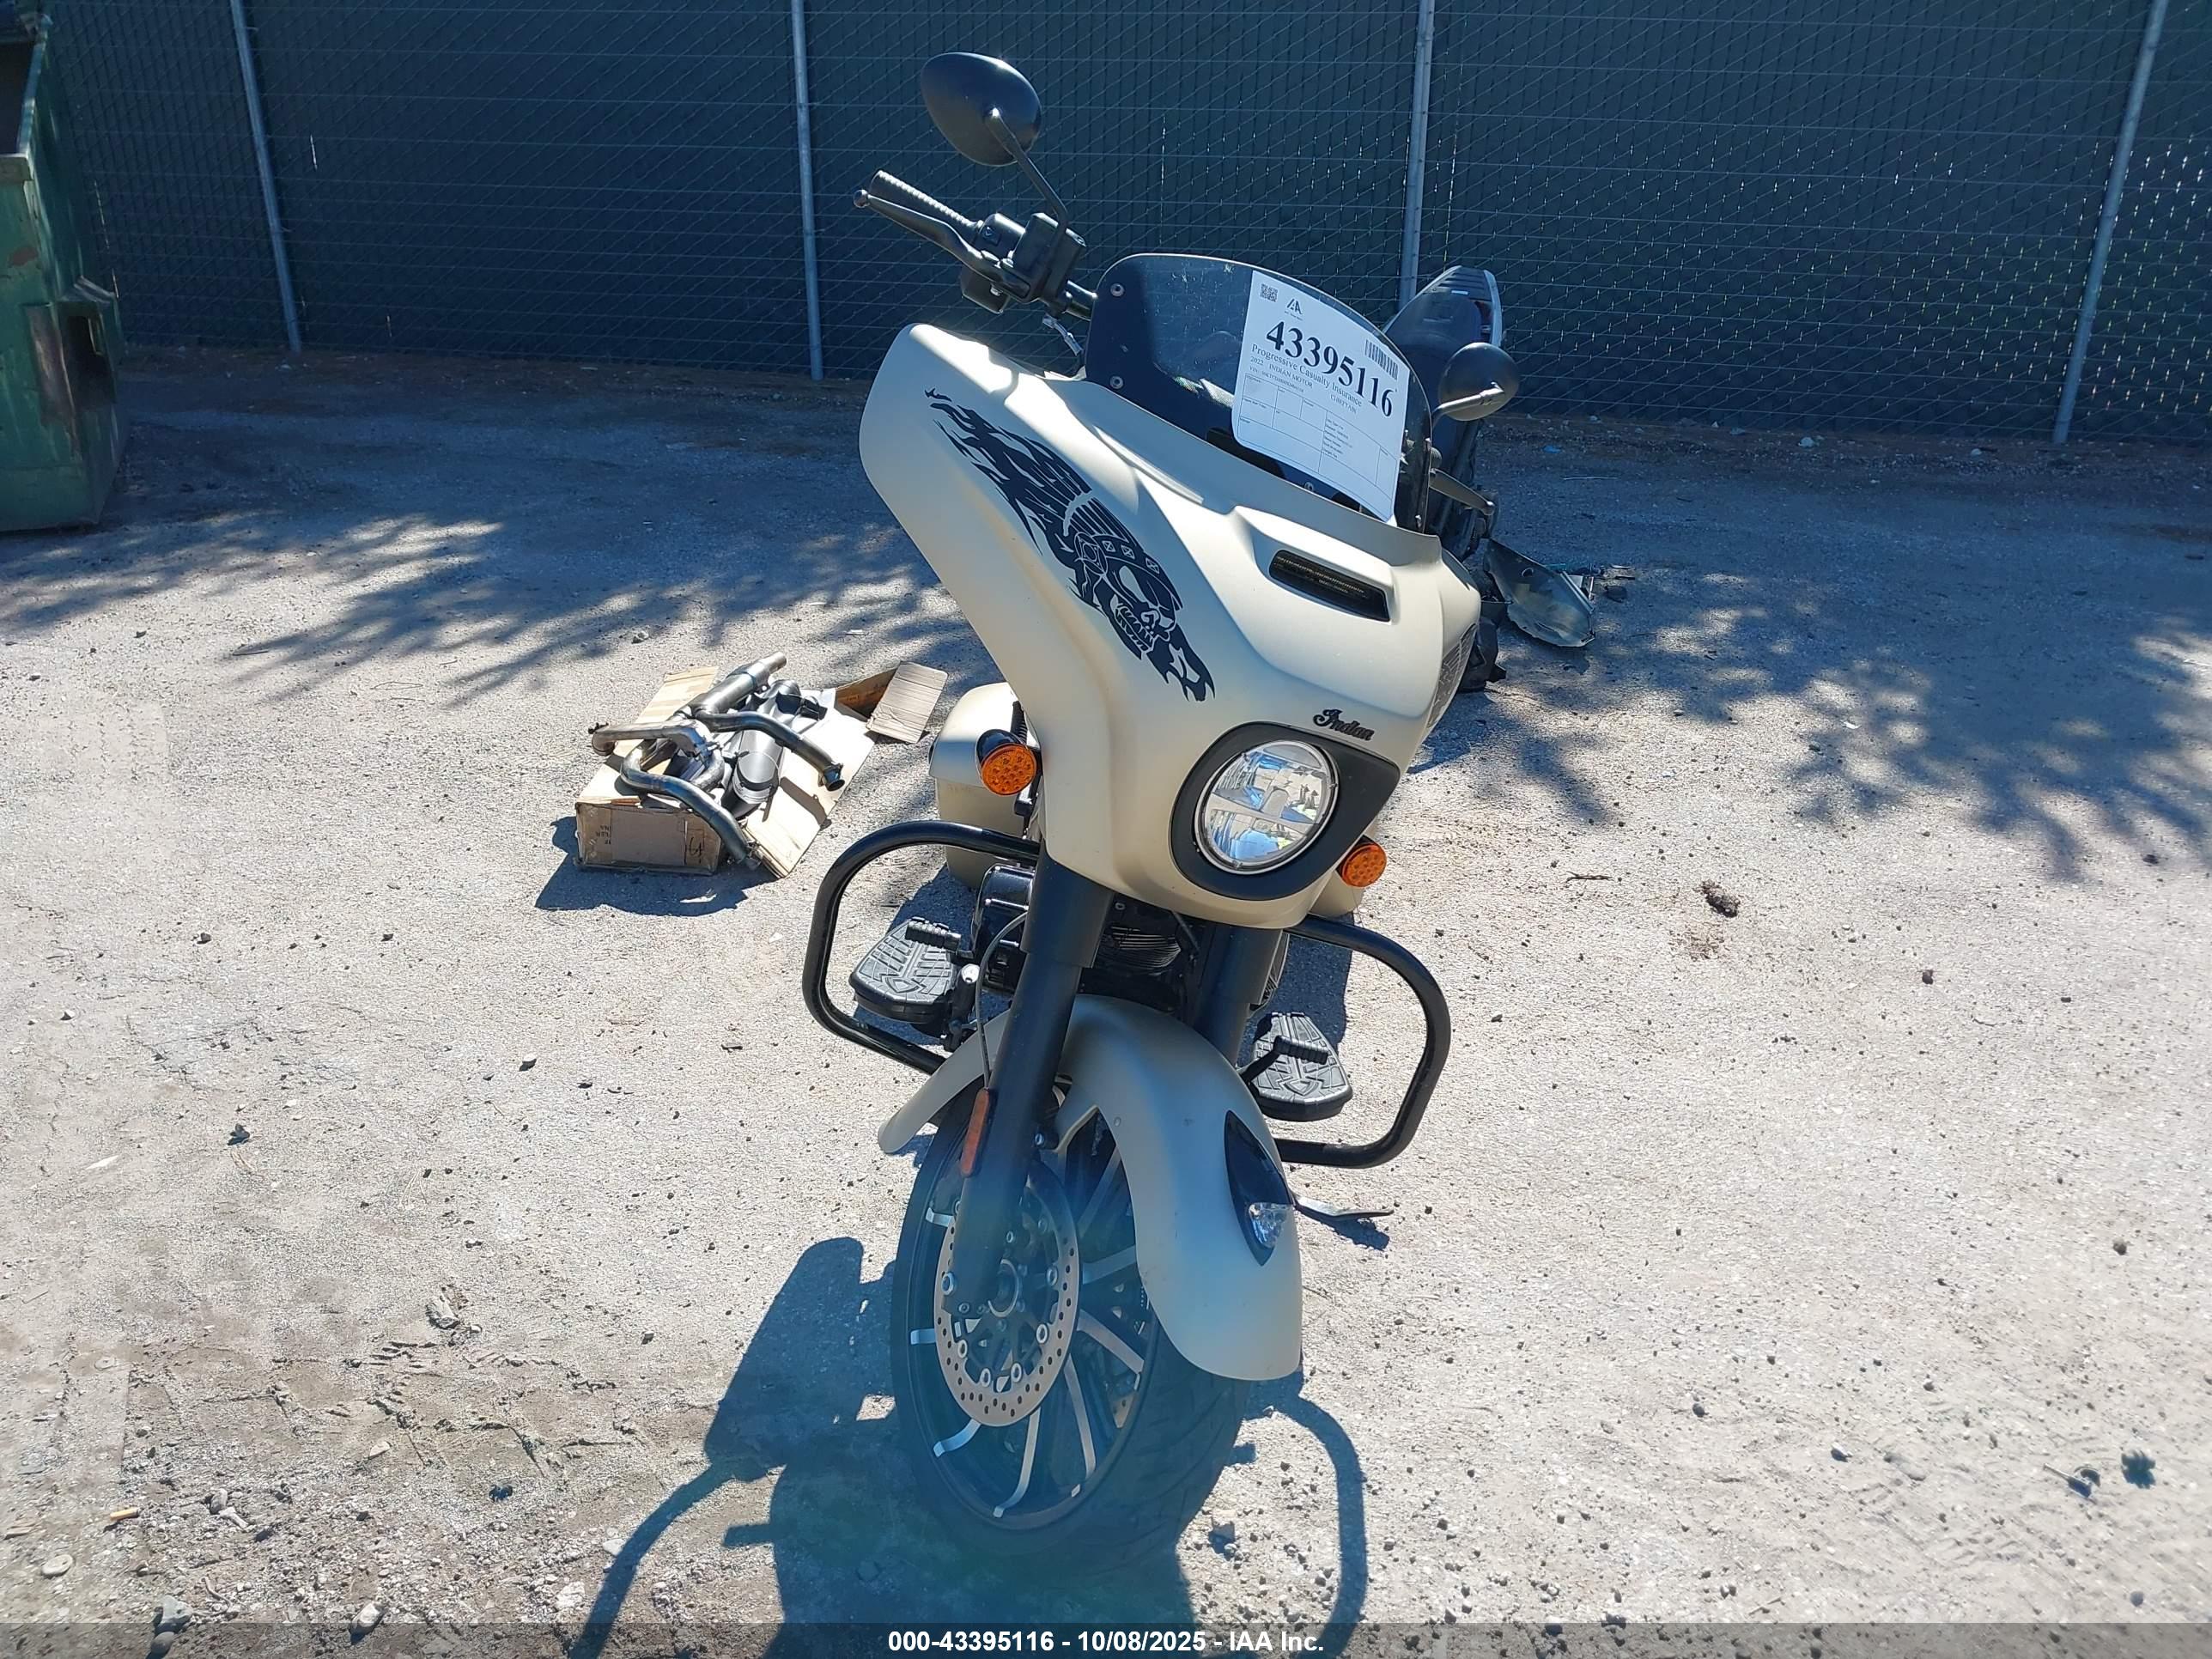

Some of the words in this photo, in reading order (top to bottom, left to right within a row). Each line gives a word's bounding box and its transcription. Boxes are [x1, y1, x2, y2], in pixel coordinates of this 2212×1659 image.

[1250, 356, 1264, 366] 2022
[1269, 363, 1291, 378] INDIAN
[1251, 343, 1297, 370] Progressive
[1299, 365, 1330, 388] Casualty
[1332, 382, 1362, 406] Insurance
[1266, 321, 1392, 416] 43395116
[1313, 709, 1375, 741] Indian
